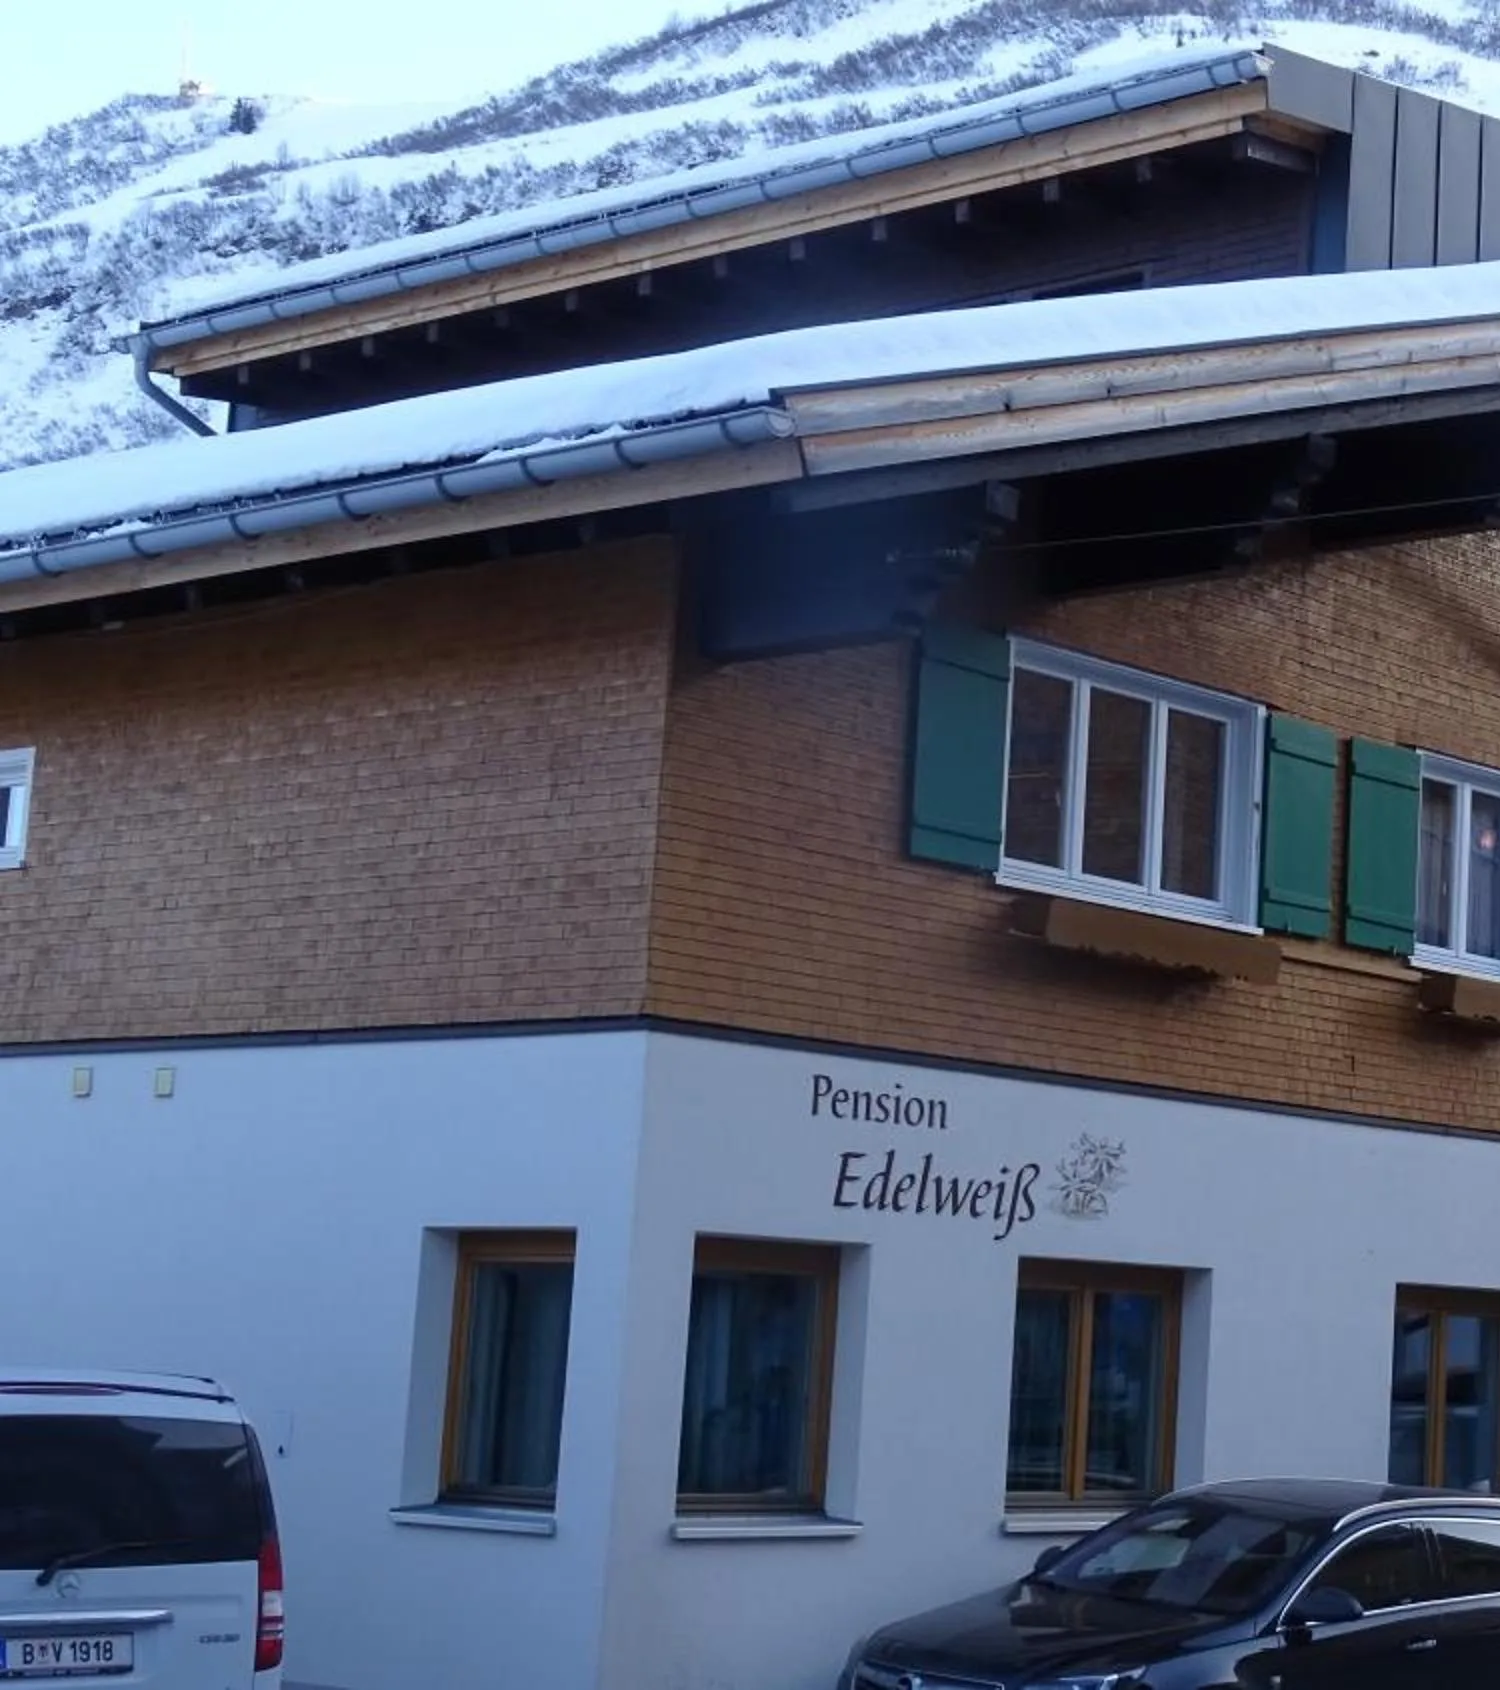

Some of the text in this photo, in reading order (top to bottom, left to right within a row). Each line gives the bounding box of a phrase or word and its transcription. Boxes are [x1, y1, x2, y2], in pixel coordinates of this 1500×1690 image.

[811, 1073, 948, 1130] Pension
[833, 1150, 1041, 1241] Edelweiß
[70, 1640, 113, 1663] 1918
